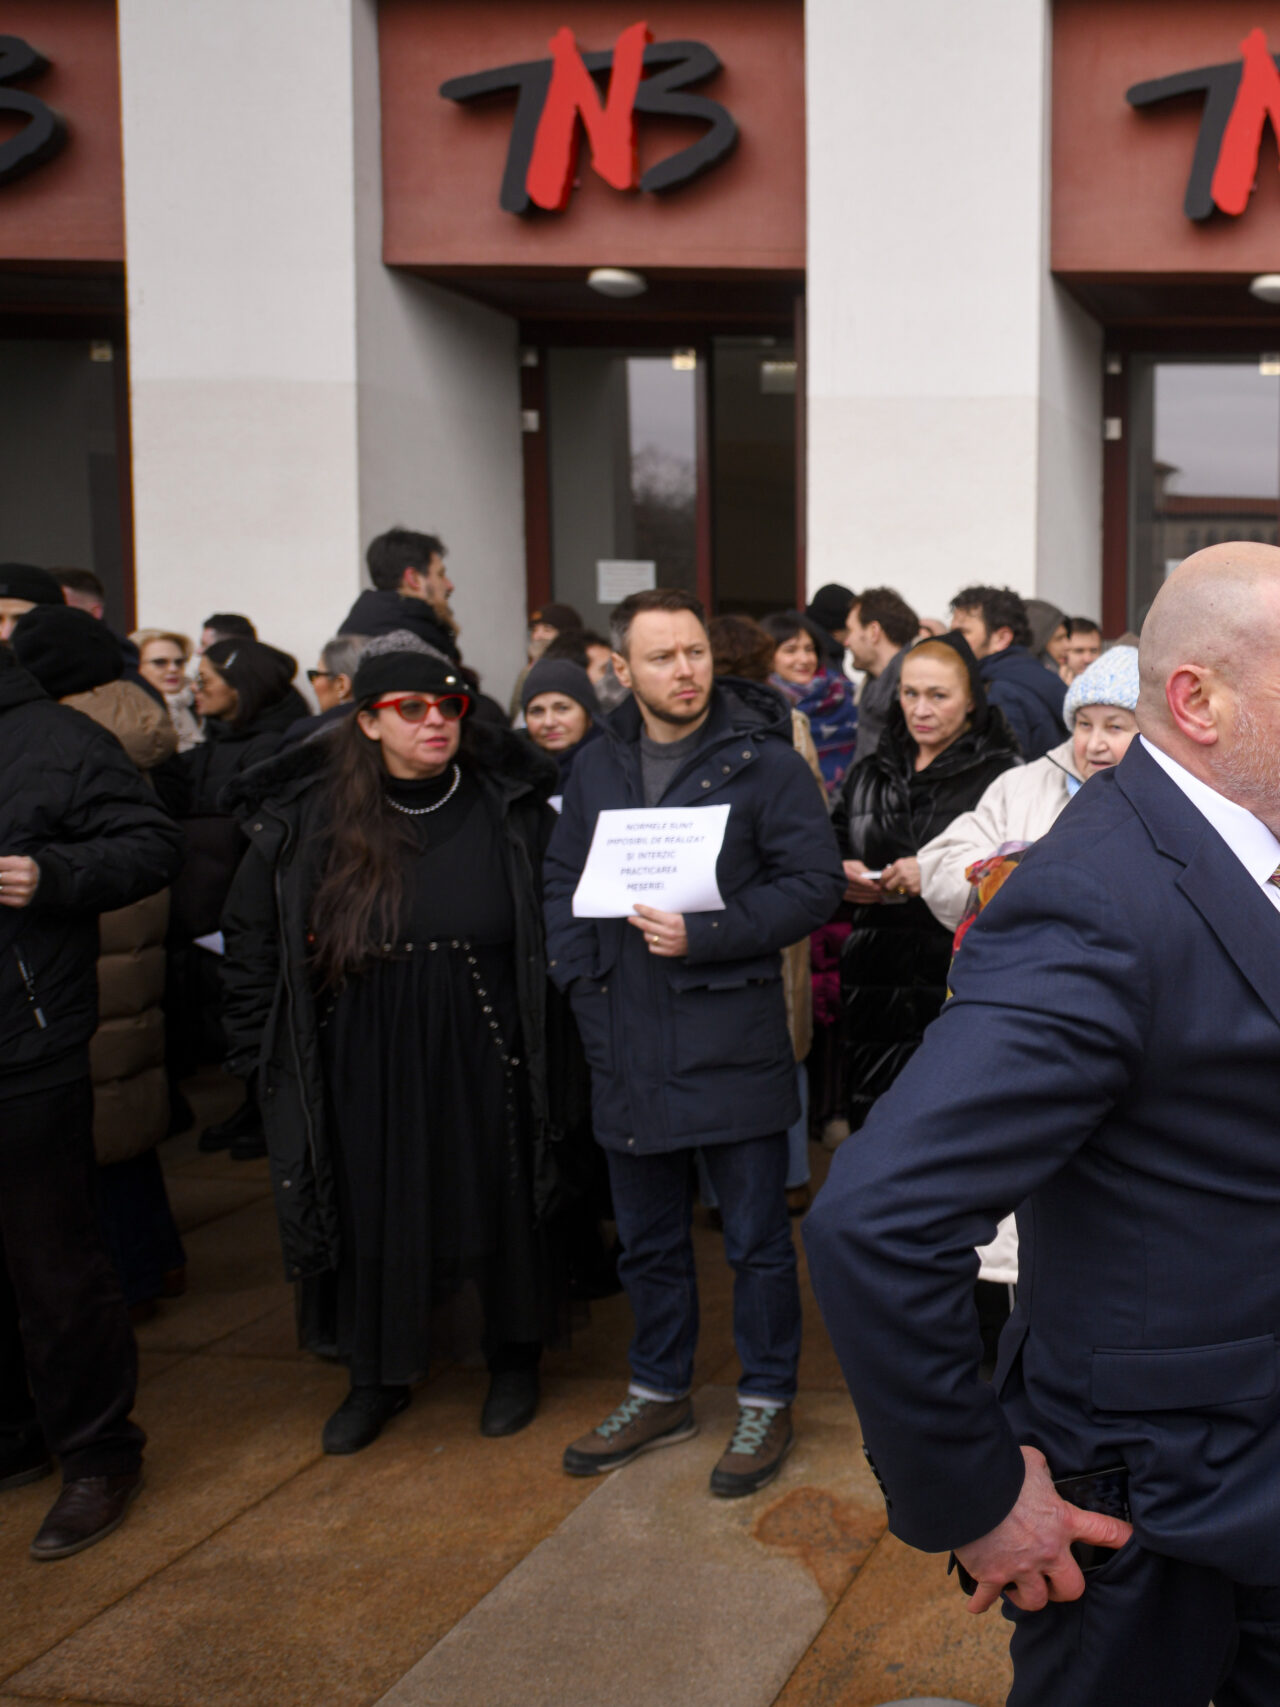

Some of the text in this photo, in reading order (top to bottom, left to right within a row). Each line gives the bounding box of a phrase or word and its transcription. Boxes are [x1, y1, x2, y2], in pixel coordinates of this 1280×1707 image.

[439, 22, 739, 214] TNB
[626, 821, 694, 831] NORMELE SUNT
[606, 835, 705, 847] IMPOSIBIL DE REALIZAT
[637, 850, 677, 861] INTERZIC
[620, 865, 678, 876] PRACTICAREA
